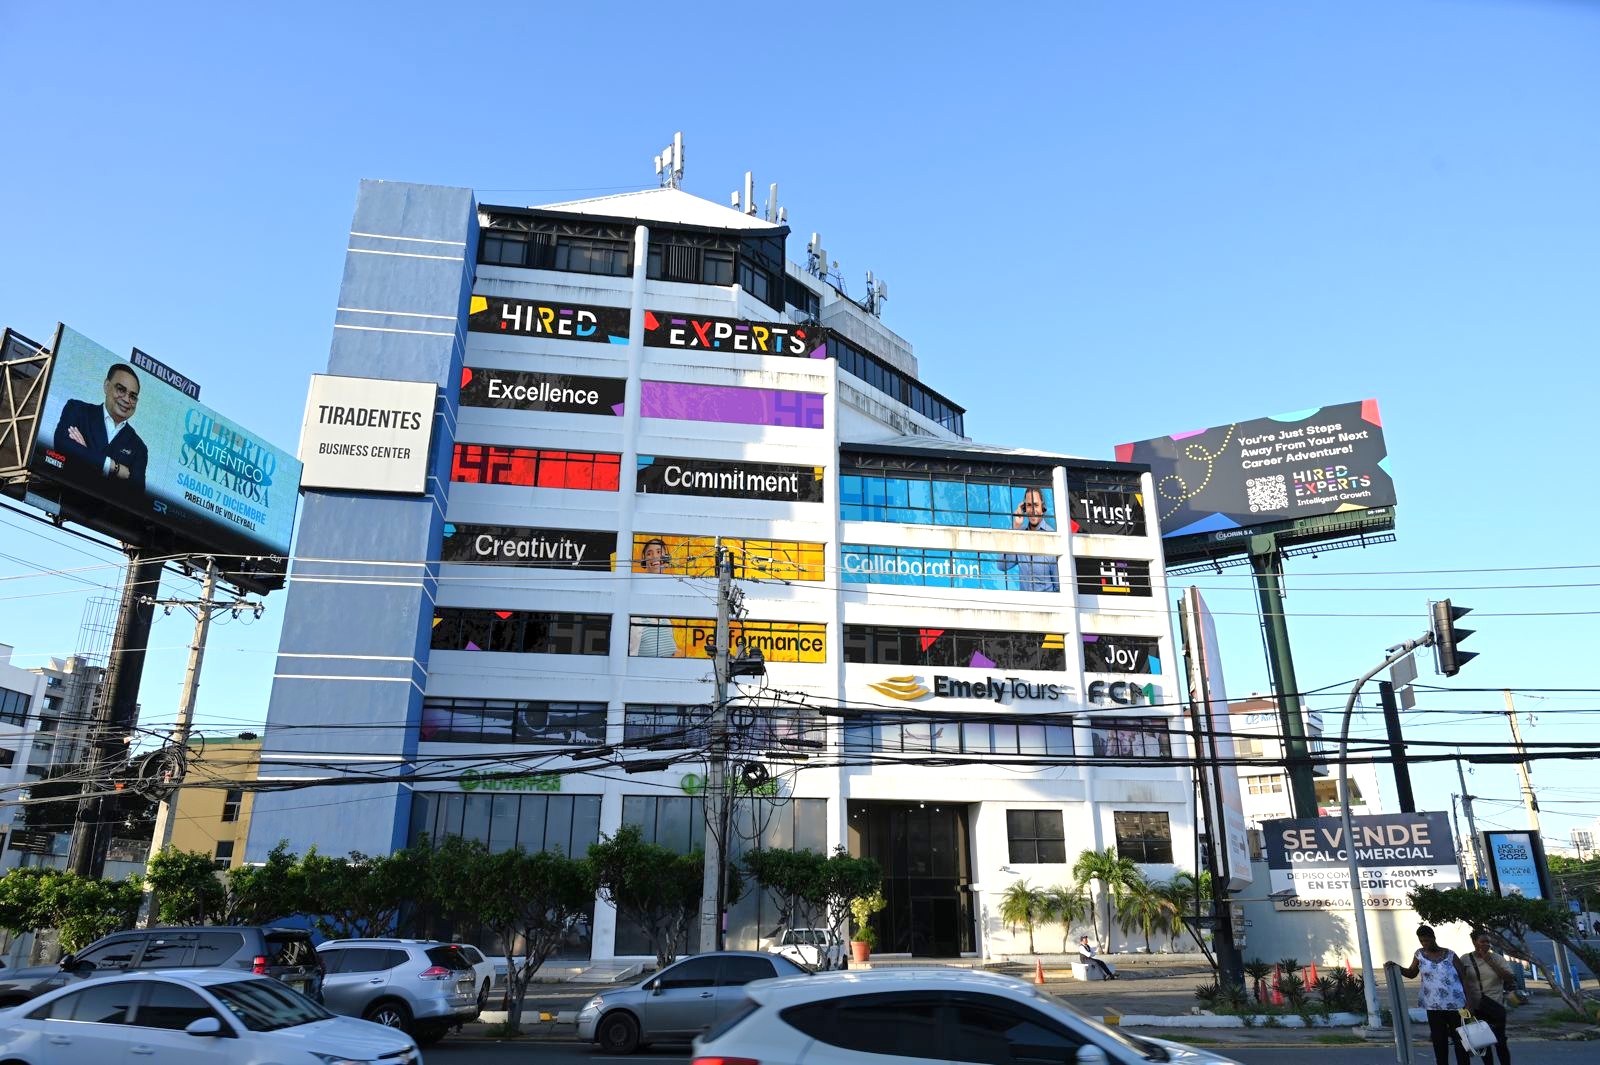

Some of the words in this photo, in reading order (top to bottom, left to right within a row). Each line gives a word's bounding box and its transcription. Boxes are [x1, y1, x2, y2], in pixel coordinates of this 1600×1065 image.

[502, 304, 597, 337] HIRED
[669, 319, 806, 354] EXPERTS
[488, 379, 599, 405] Excellence
[319, 405, 422, 430] TIRADENTES
[1278, 429, 1304, 440] Just
[1306, 423, 1342, 434] Steps
[319, 442, 368, 457] BUSINESS
[371, 446, 410, 460] CENTER
[1240, 445, 1273, 458] Away
[1275, 440, 1306, 453] From
[1307, 436, 1336, 447] Your
[1338, 430, 1368, 441] Next
[195, 439, 263, 483] AUTÉNTICO
[1242, 456, 1283, 469] Career
[1286, 445, 1353, 463] Adventure!
[664, 465, 798, 493] Commitment
[1293, 465, 1348, 483] HIRED
[1294, 475, 1371, 497] EXPERTS
[177, 472, 214, 499] SÁBADO
[216, 490, 221, 502] 7
[222, 495, 267, 525] DICIEMBRE
[1297, 495, 1339, 506] Intelligent
[1340, 490, 1371, 500] Growth
[215, 505, 222, 515] DE
[223, 509, 257, 532] VOLLEYBALL
[1081, 499, 1134, 526] Trust
[475, 534, 587, 566] Creativity
[843, 553, 980, 579] Collaboration
[692, 629, 823, 653] Peformance
[1105, 645, 1139, 671] Joy
[1282, 829, 1318, 850] SE
[1285, 851, 1335, 863] LOCAL
[1287, 872, 1300, 880] DE
[1302, 872, 1325, 880] PISO
[1308, 881, 1324, 889] EN
[1327, 880, 1351, 890] EST
[1361, 879, 1417, 889] EDIFICIO
[1324, 899, 1351, 907] 6404
[1383, 898, 1402, 906] 979
